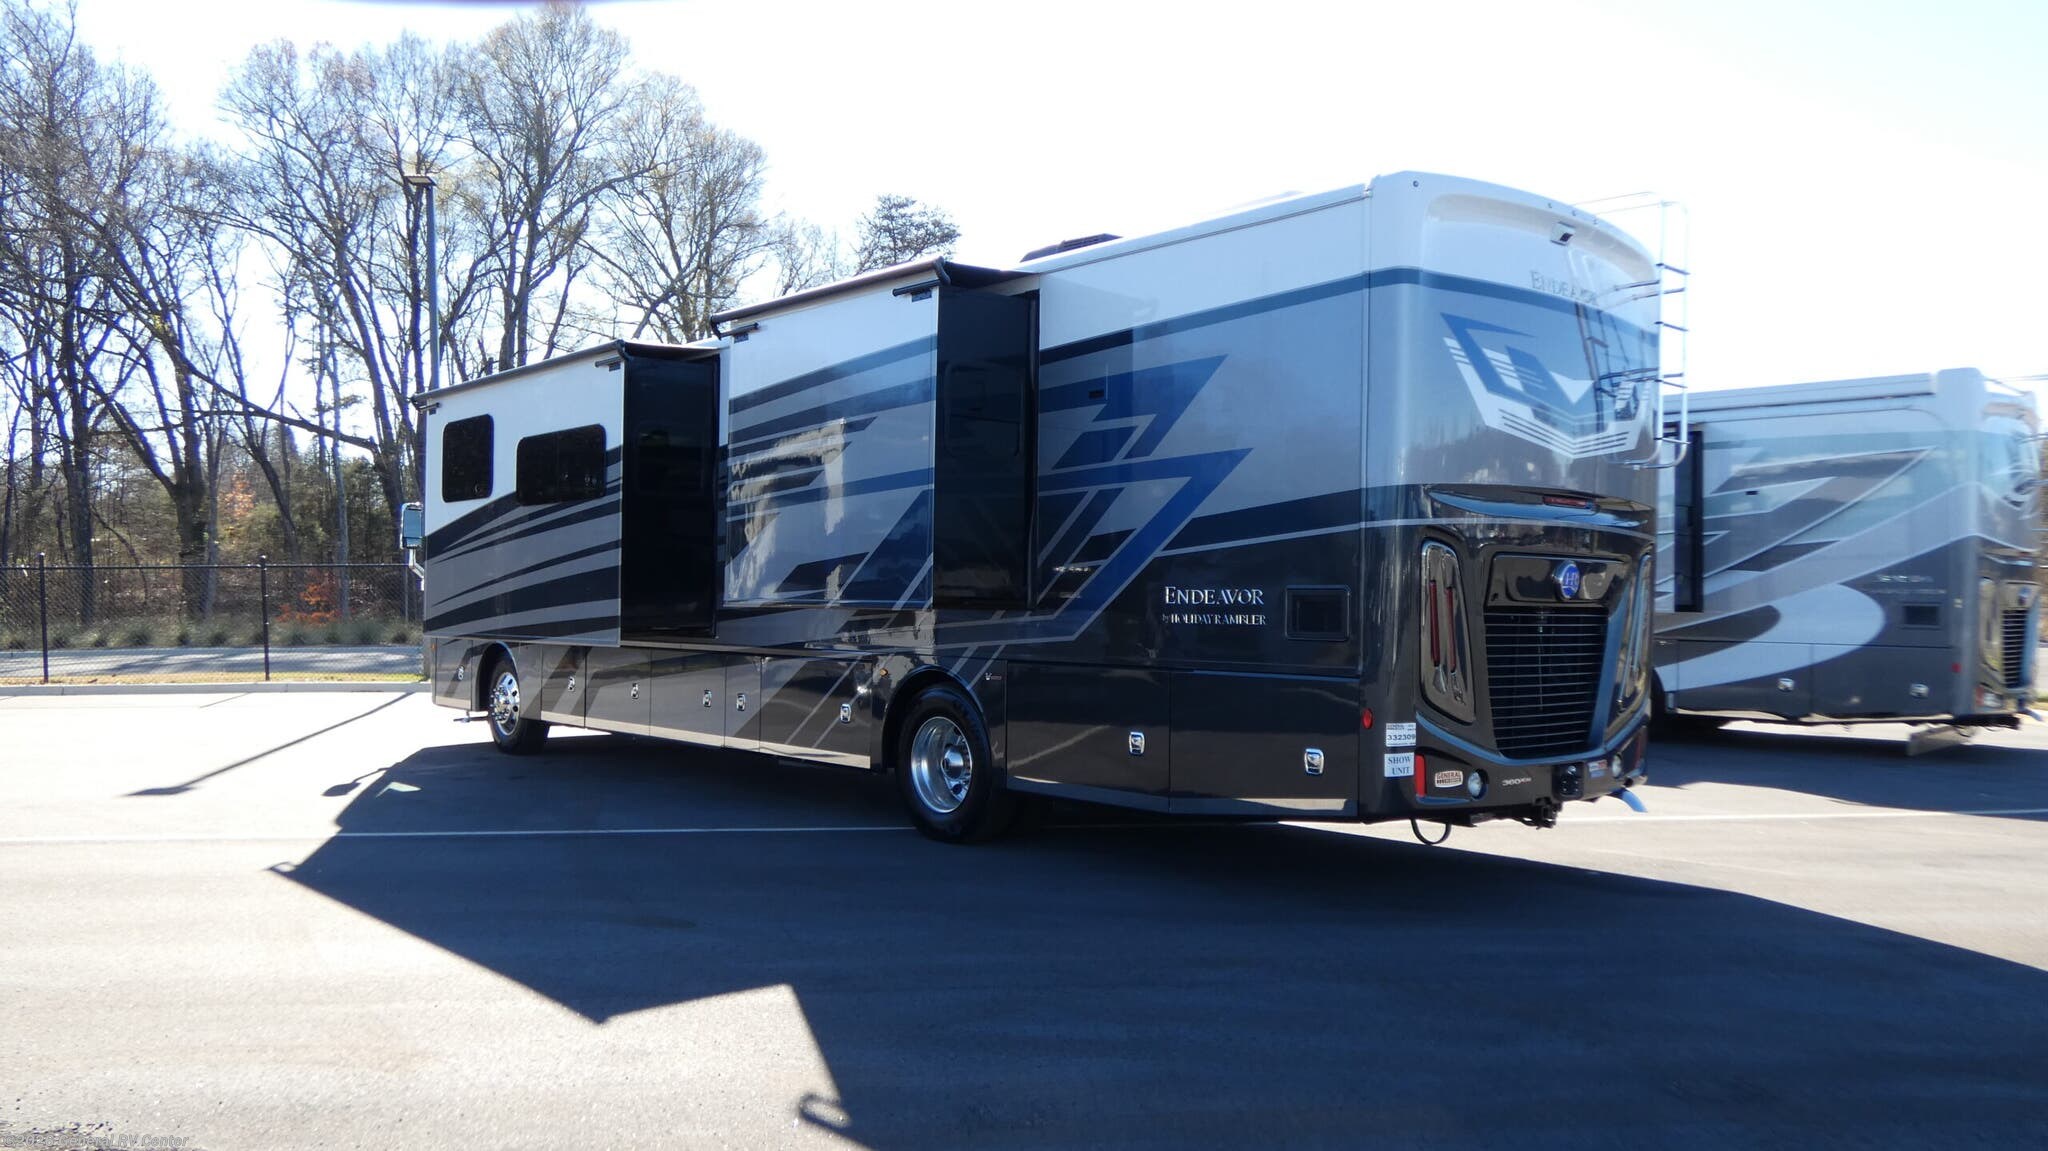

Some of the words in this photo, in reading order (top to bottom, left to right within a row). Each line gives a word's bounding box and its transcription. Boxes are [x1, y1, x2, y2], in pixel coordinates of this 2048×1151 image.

[1164, 586, 1265, 605] ENDEAVOR
[1214, 614, 1266, 625] RAMBLER
[1388, 756, 1411, 765] SHOW
[1392, 767, 1410, 775] UNIT
